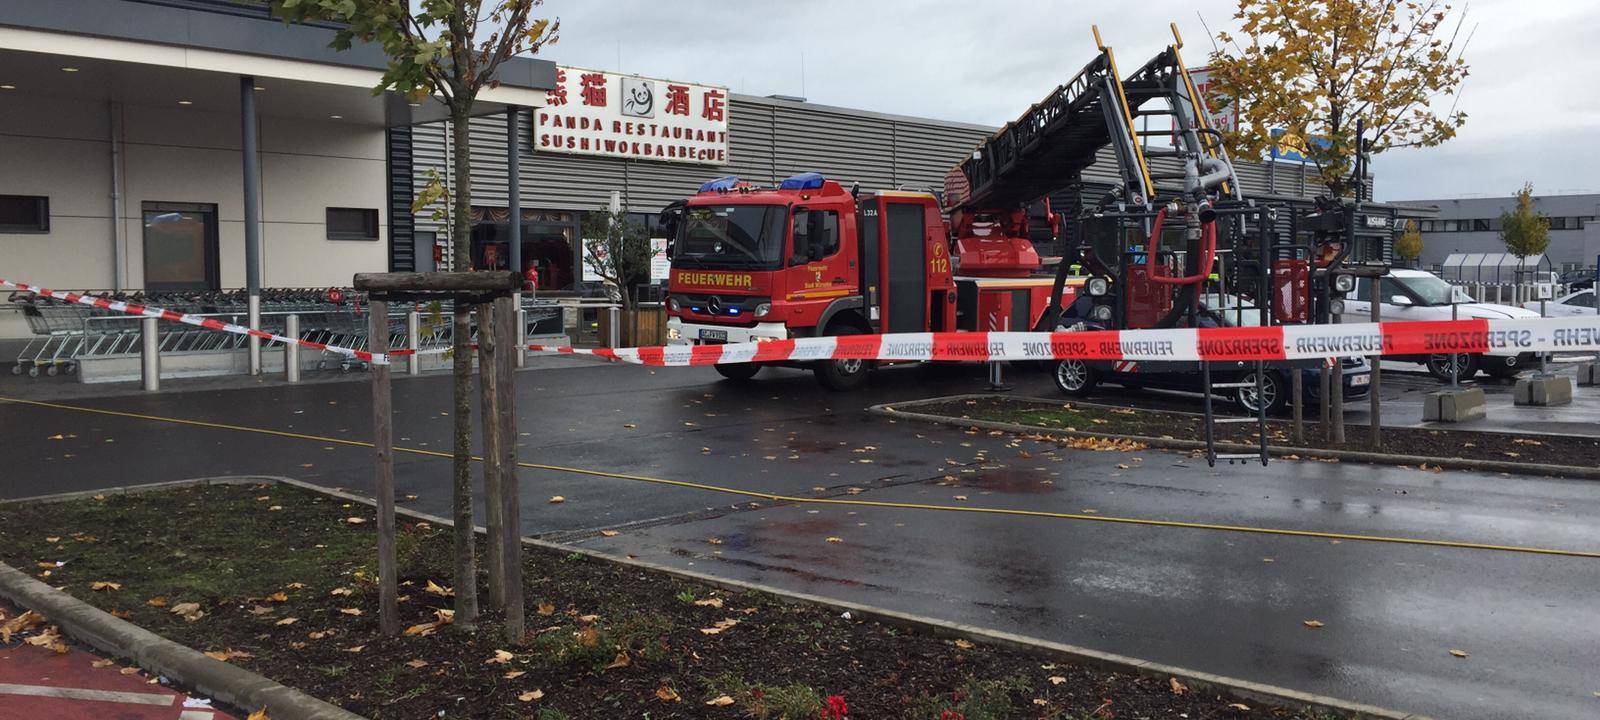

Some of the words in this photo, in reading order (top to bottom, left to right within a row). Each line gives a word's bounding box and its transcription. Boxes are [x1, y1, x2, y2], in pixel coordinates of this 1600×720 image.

[664, 83, 725, 122] 酒店
[540, 112, 603, 131] PANDA
[613, 120, 726, 143] RESTAURANT
[930, 258, 947, 273] 112
[677, 272, 752, 287] FEUERWEHR
